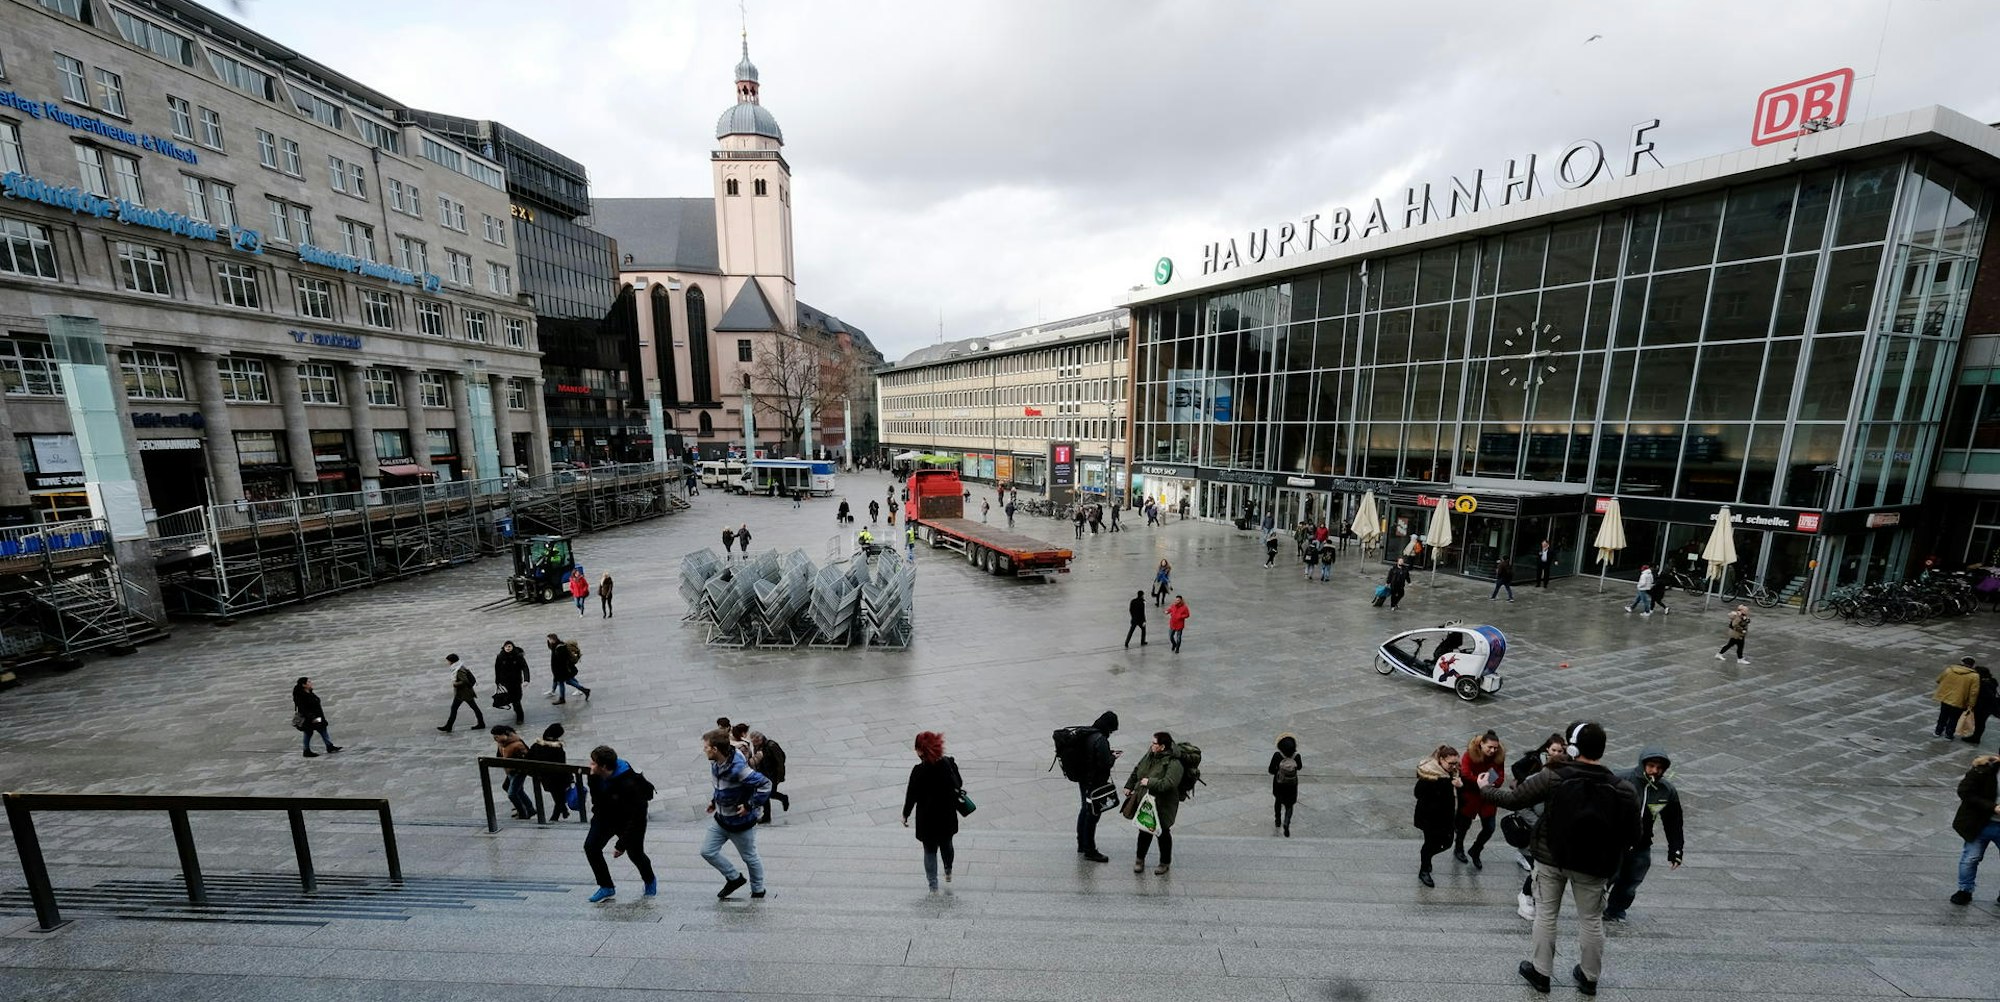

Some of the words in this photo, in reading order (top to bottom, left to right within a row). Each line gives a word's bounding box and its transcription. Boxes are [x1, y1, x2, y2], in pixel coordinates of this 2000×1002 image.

[1763, 82, 1836, 135] DB
[43, 101, 137, 145] Kiepenheuer
[141, 134, 154, 151] &
[154, 135, 199, 165] Witsch
[1201, 118, 1661, 276] HAUPTBAHNHOF
[1156, 260, 1168, 282] S
[1142, 466, 1151, 474] THE
[1151, 467, 1164, 475] BODY
[1164, 468, 1177, 476] SHOP
[1746, 514, 1790, 527] schneller.
